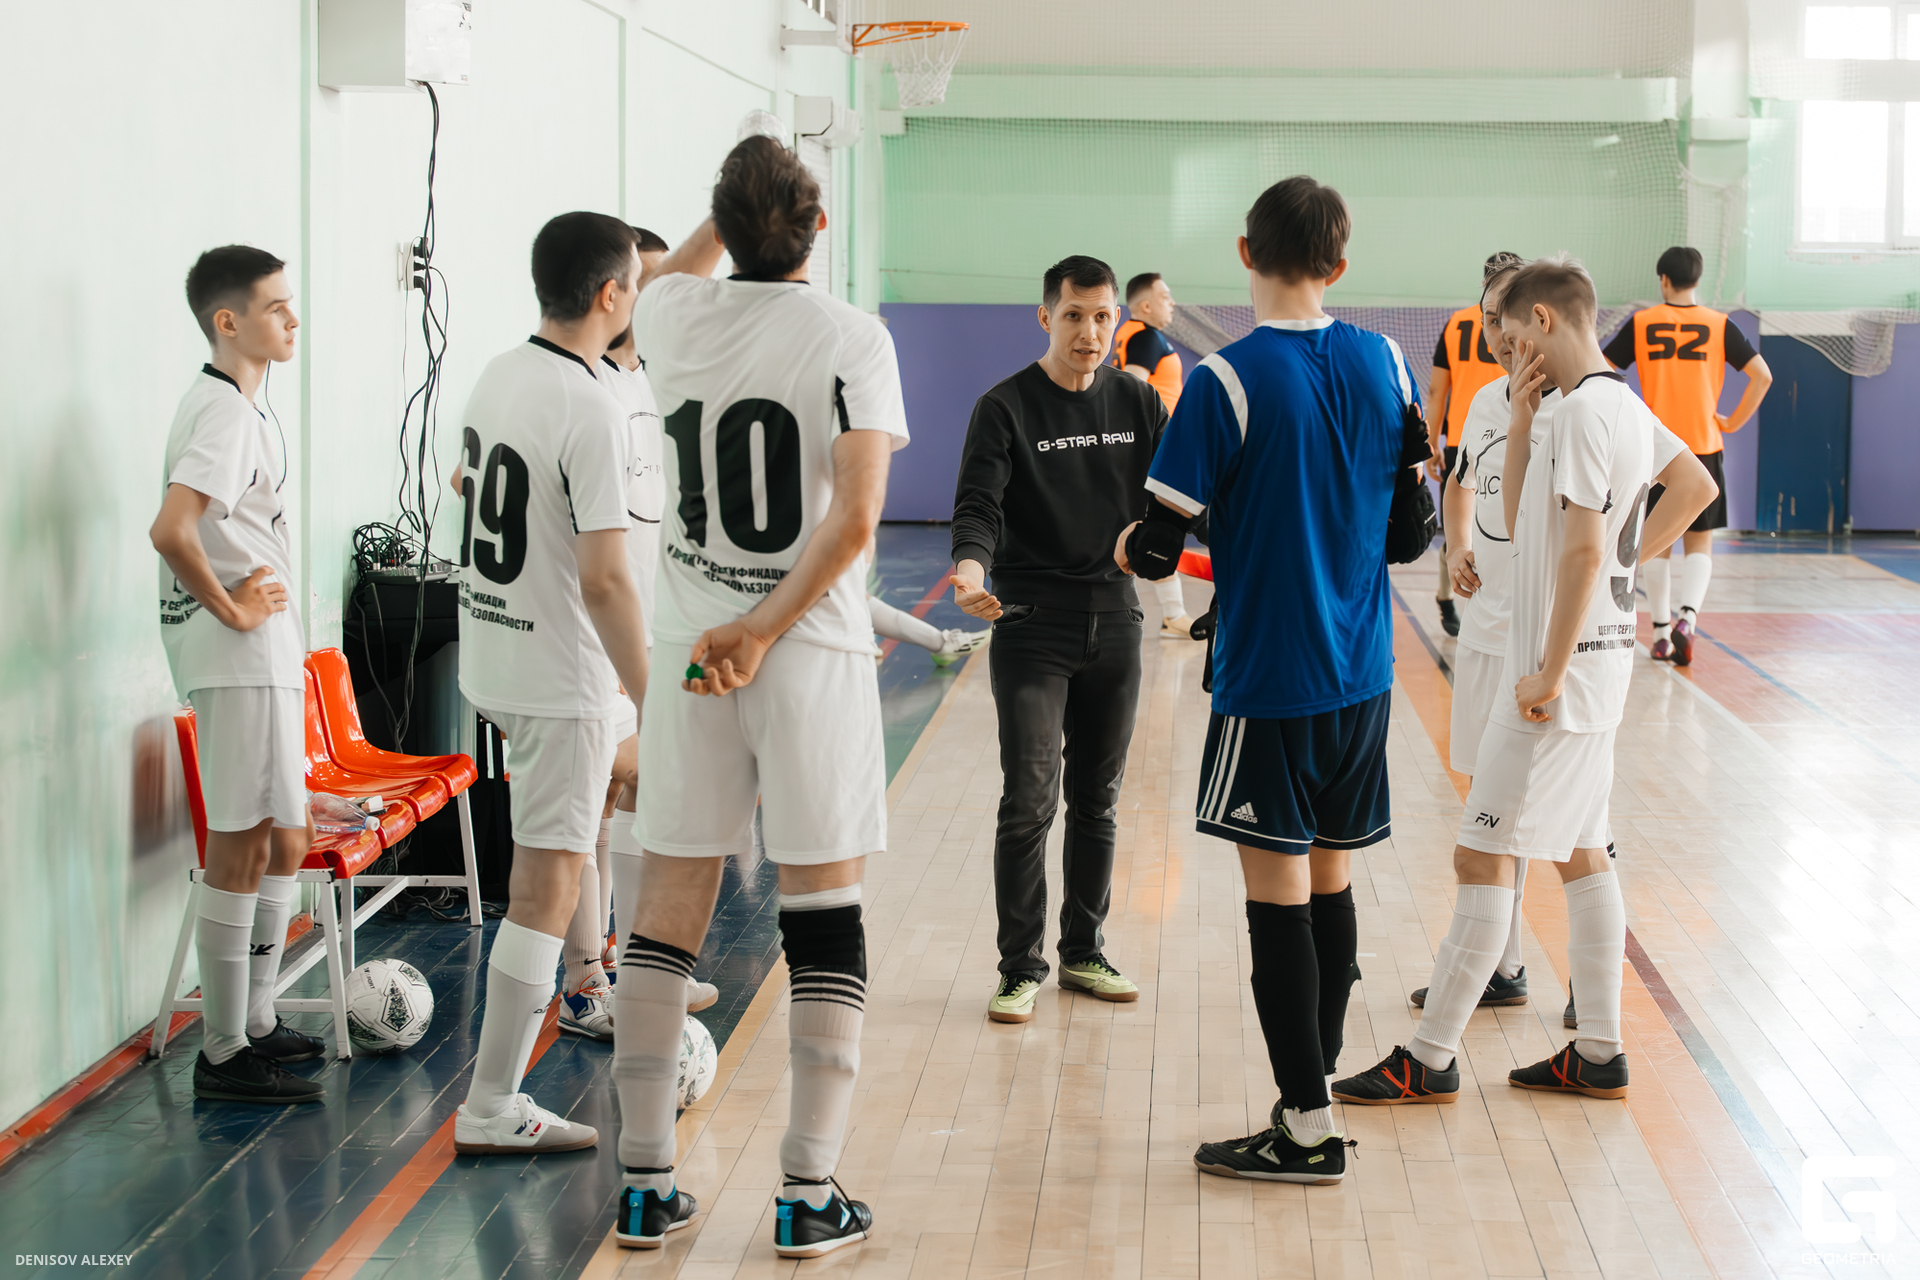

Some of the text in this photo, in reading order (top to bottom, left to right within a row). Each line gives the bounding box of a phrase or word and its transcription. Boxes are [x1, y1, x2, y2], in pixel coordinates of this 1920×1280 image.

[1646, 323, 1710, 362] 52
[1037, 431, 1135, 452] G-STAR RAW
[664, 398, 802, 554] 10
[1598, 625, 1617, 637] ЦЕНТР
[1230, 811, 1258, 824] adidas
